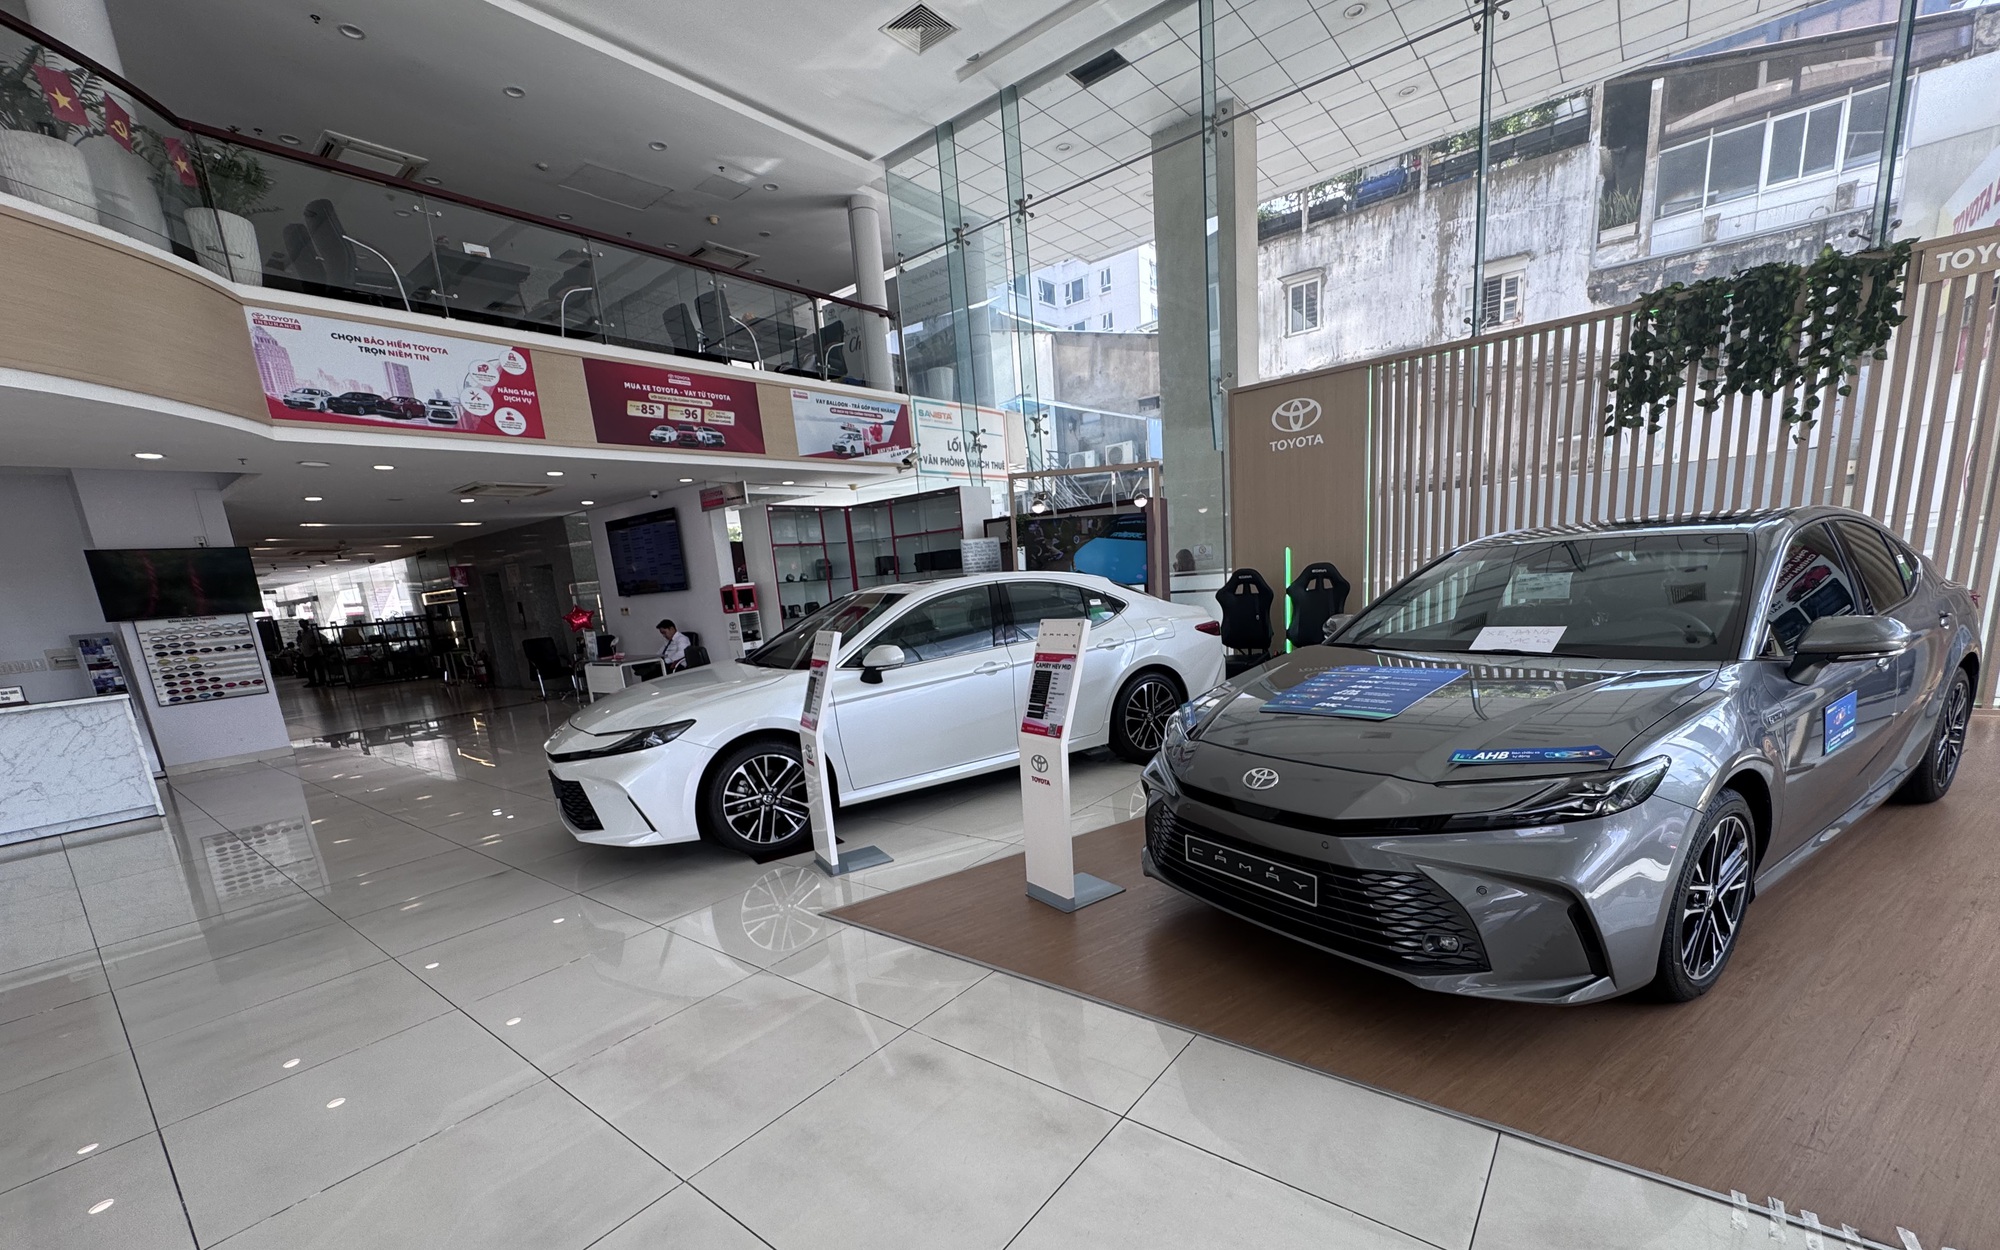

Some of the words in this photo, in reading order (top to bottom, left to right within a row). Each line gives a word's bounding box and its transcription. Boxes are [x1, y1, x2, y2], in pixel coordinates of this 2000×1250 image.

[1936, 242, 2000, 273] TOY
[255, 319, 300, 330] INSURANCE
[265, 314, 300, 324] TOYOTA
[330, 332, 362, 344] CHỌN
[363, 336, 385, 346] BẢO
[386, 340, 411, 349] HIỂM
[412, 343, 449, 356] TOYOTA
[357, 345, 387, 357] TRỌN
[414, 353, 430, 361] TIN
[497, 387, 520, 396] NÂNG
[624, 381, 641, 391] MUA
[642, 384, 651, 392] XE
[652, 385, 679, 396] TOYOTA
[683, 389, 697, 398] VAY
[707, 392, 731, 402] TOYOTA
[503, 395, 521, 403] DỊCH
[521, 397, 532, 405] VỤ
[826, 399, 848, 408] BALLOON
[684, 408, 698, 420] 96
[918, 409, 952, 420] SAVISTA
[947, 436, 962, 452] LỐI
[1269, 433, 1324, 452] TOYOTA
[922, 454, 939, 465] VĂN
[940, 456, 965, 467] PHÒNG
[1473, 751, 1510, 760] AHB
[1031, 775, 1051, 786] TOYOTA
